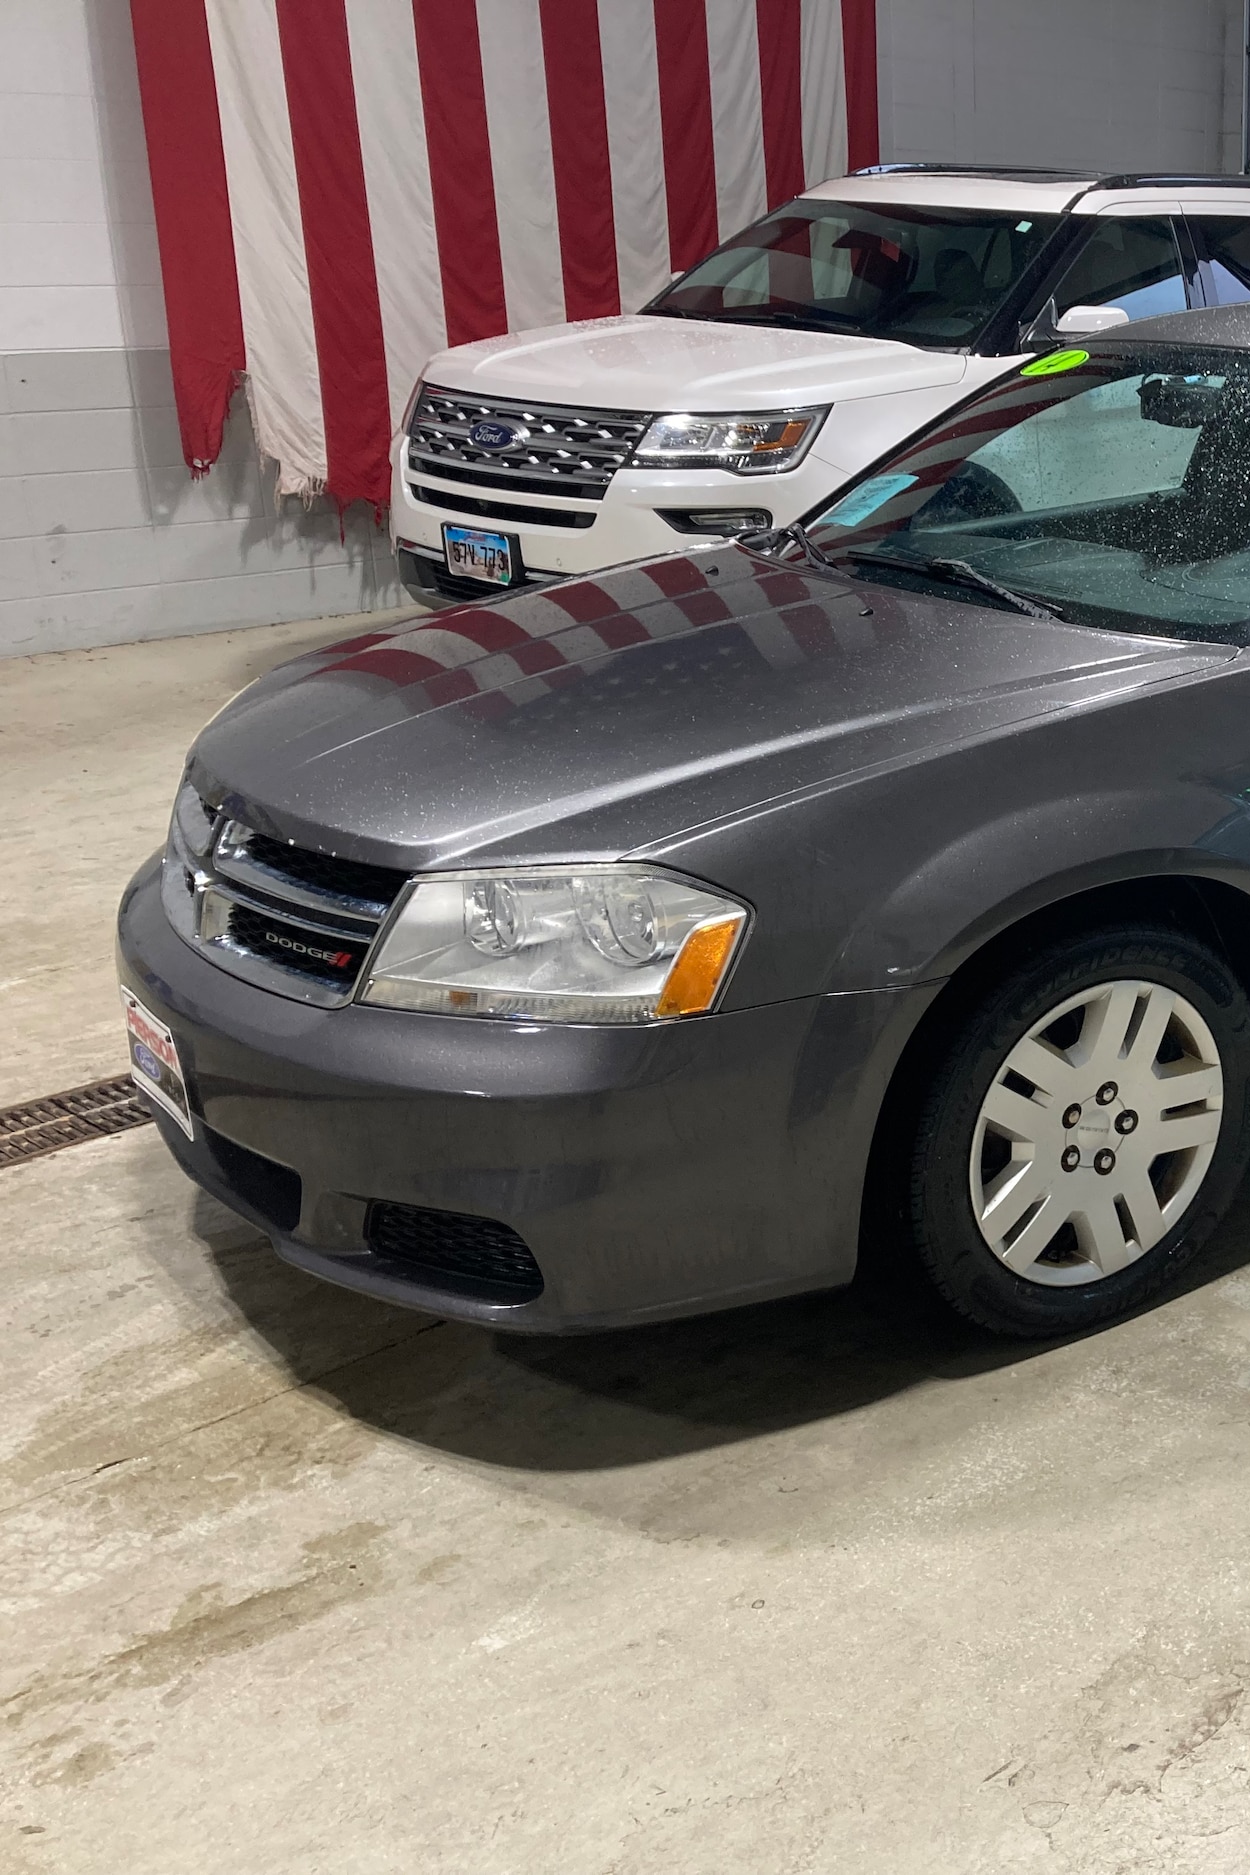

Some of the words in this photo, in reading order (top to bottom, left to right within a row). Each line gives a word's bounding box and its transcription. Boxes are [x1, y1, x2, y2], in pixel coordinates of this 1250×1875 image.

[475, 424, 503, 443] Ford
[480, 546, 505, 571] 773
[265, 932, 338, 963] DODGE
